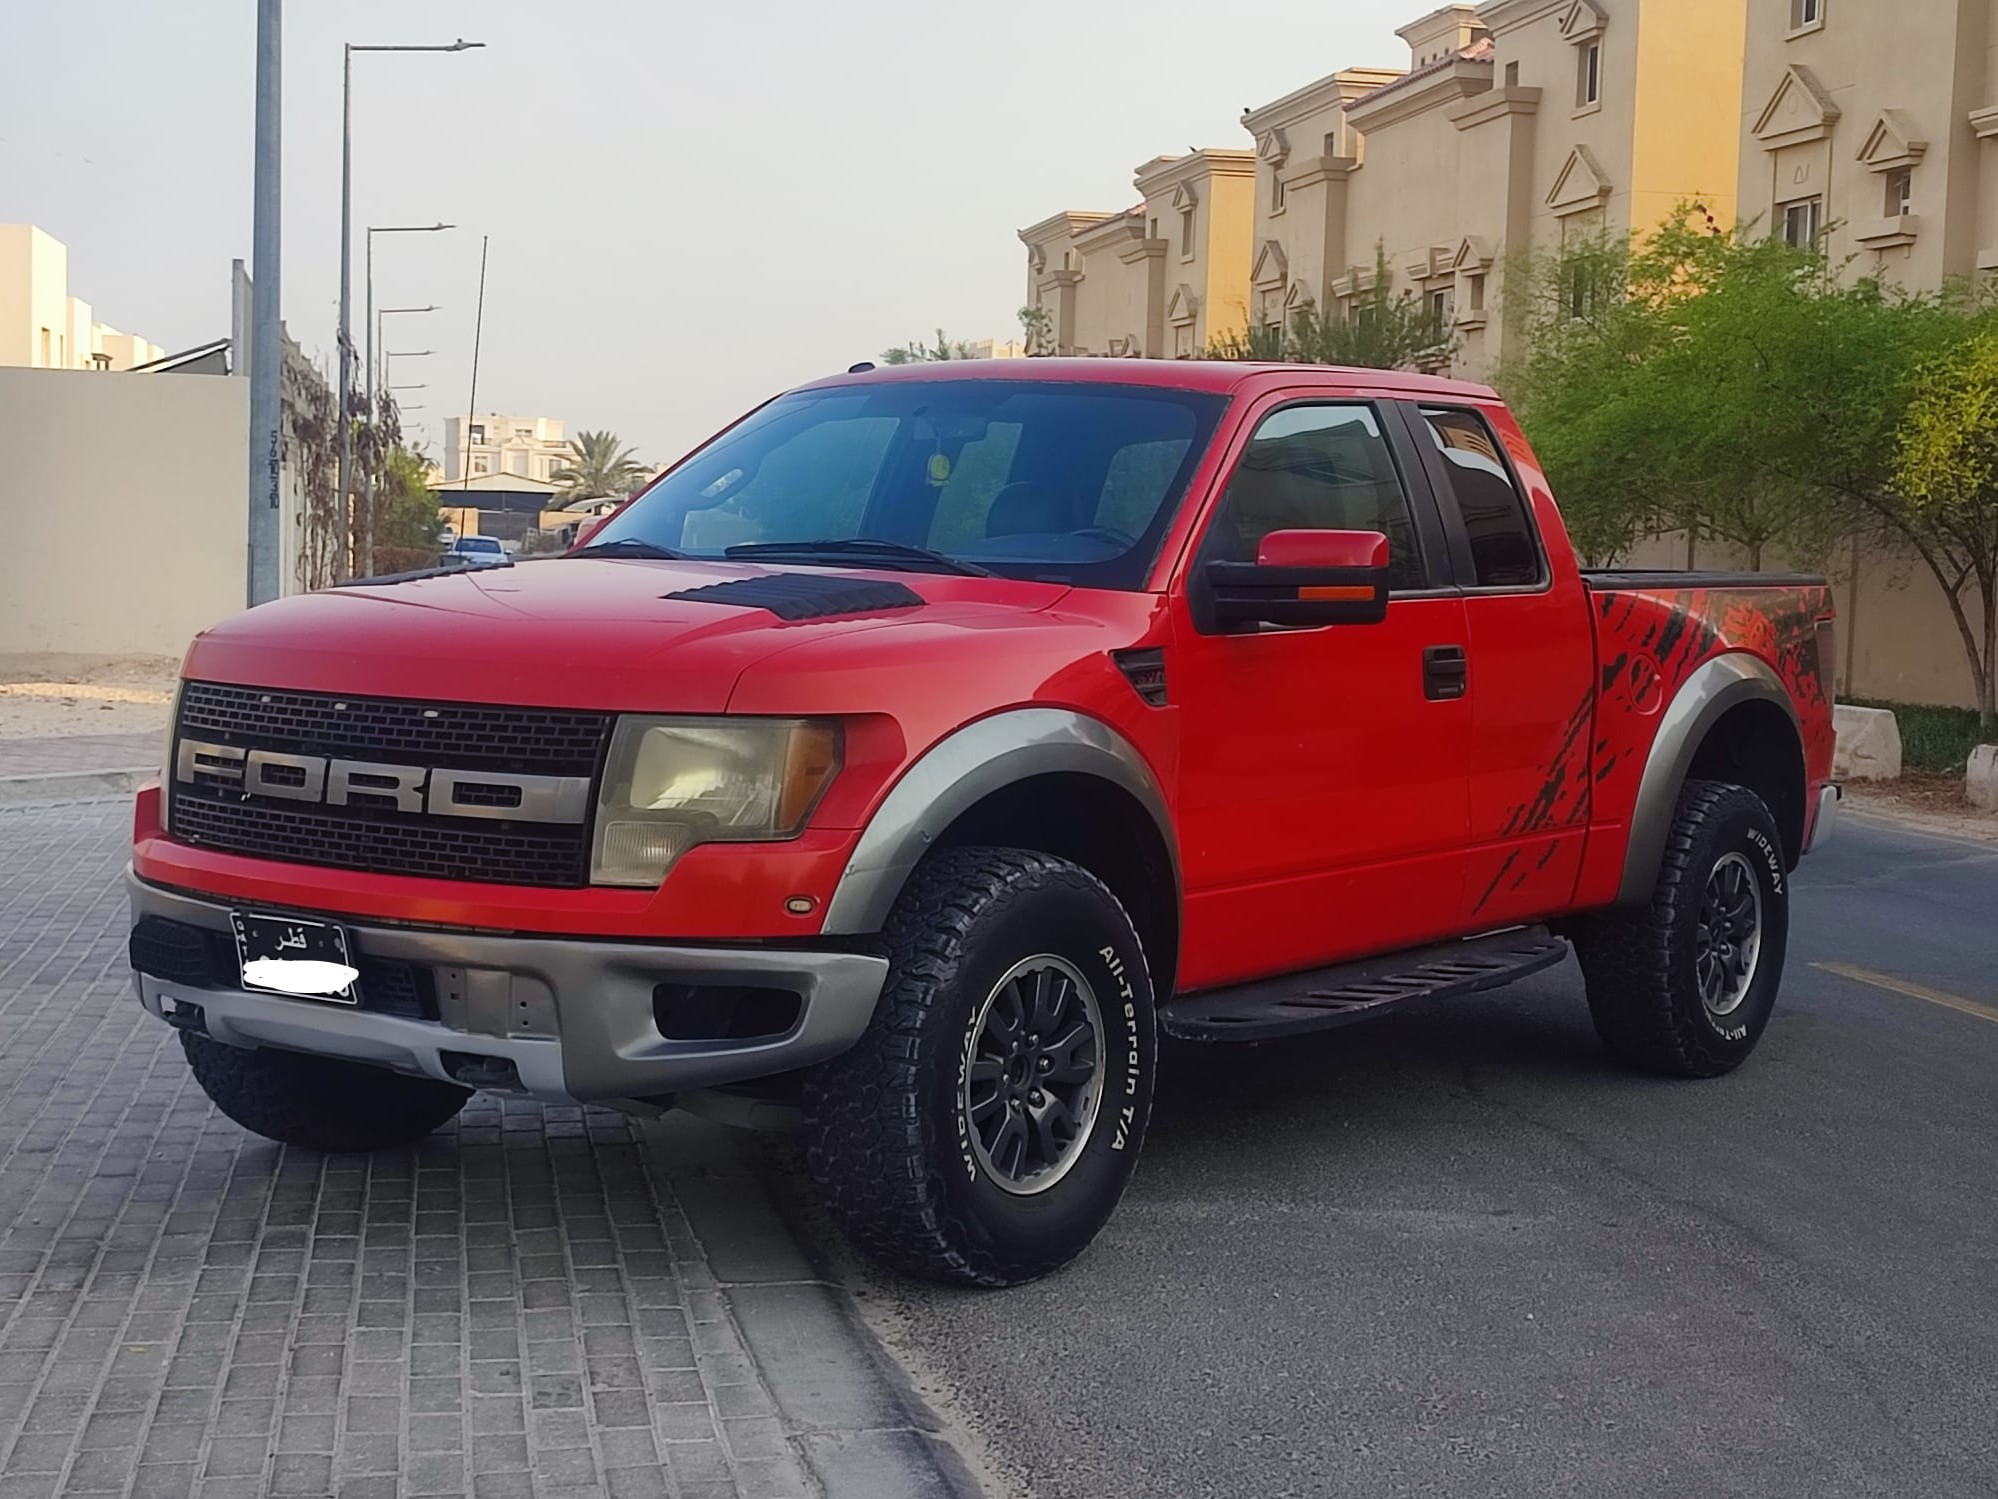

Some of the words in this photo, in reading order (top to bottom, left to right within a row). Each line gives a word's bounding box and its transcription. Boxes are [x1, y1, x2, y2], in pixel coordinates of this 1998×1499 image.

[177, 738, 591, 824] FORD
[1747, 827, 1783, 895] WIDEWAY
[275, 927, 307, 951] قطر
[1098, 945, 1140, 1095] All-Terrain
[1111, 1106, 1135, 1151] T/A
